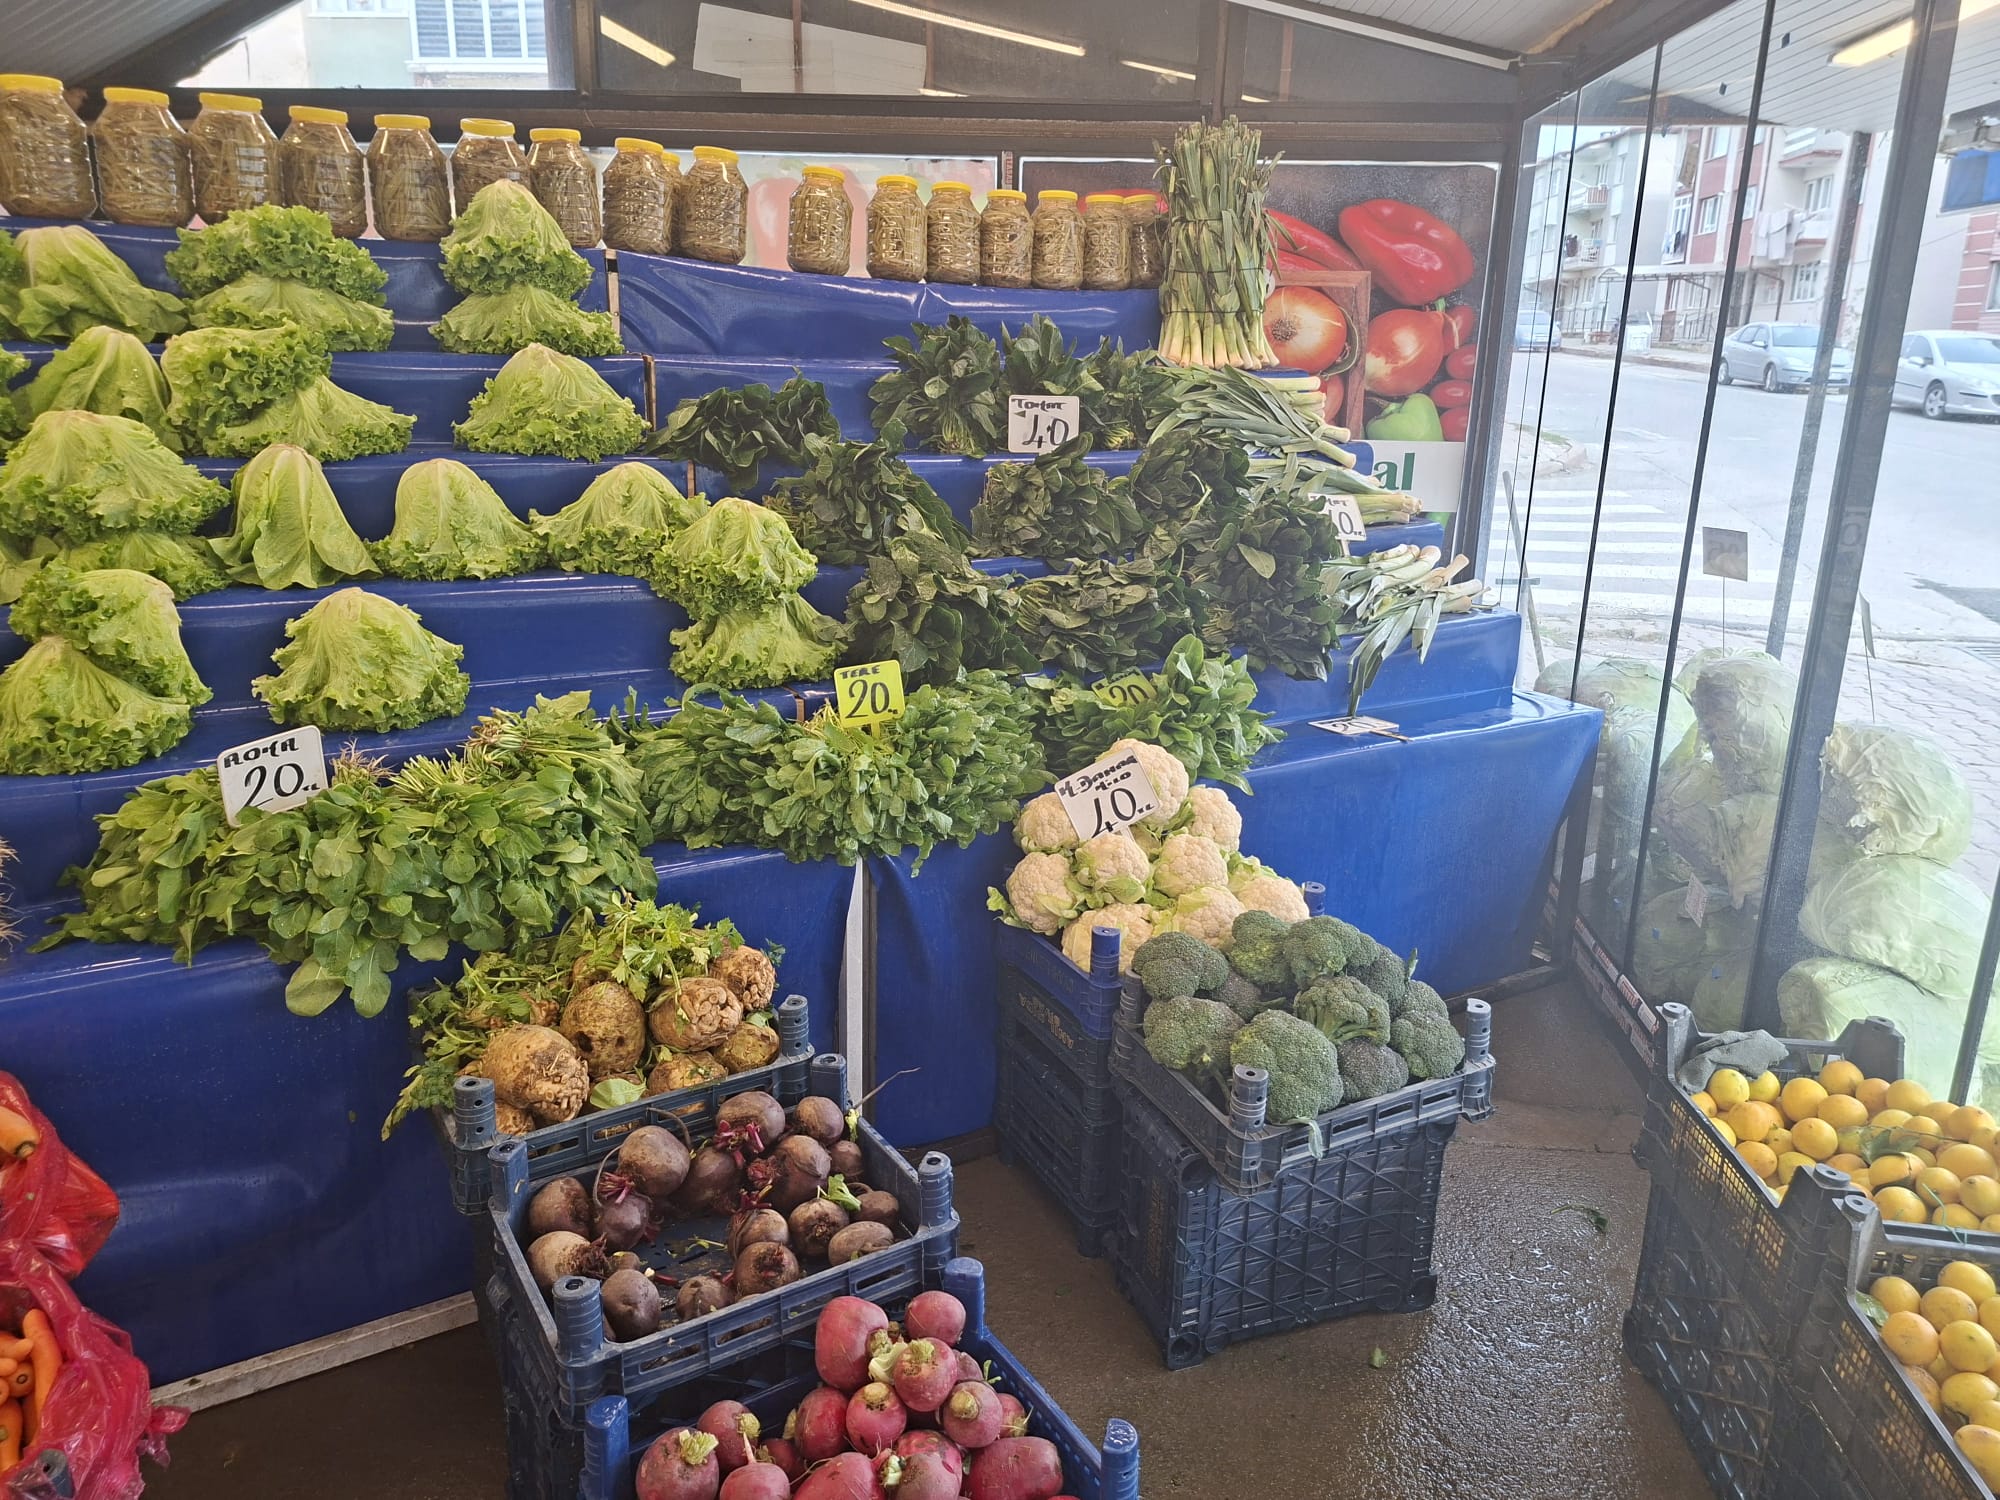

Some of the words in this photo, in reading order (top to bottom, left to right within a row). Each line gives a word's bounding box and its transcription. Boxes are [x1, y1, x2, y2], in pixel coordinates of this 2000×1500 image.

[1022, 414, 1069, 448] 40
[844, 679, 890, 718] 20
[244, 763, 304, 808] 20
[1091, 787, 1137, 839] 40
